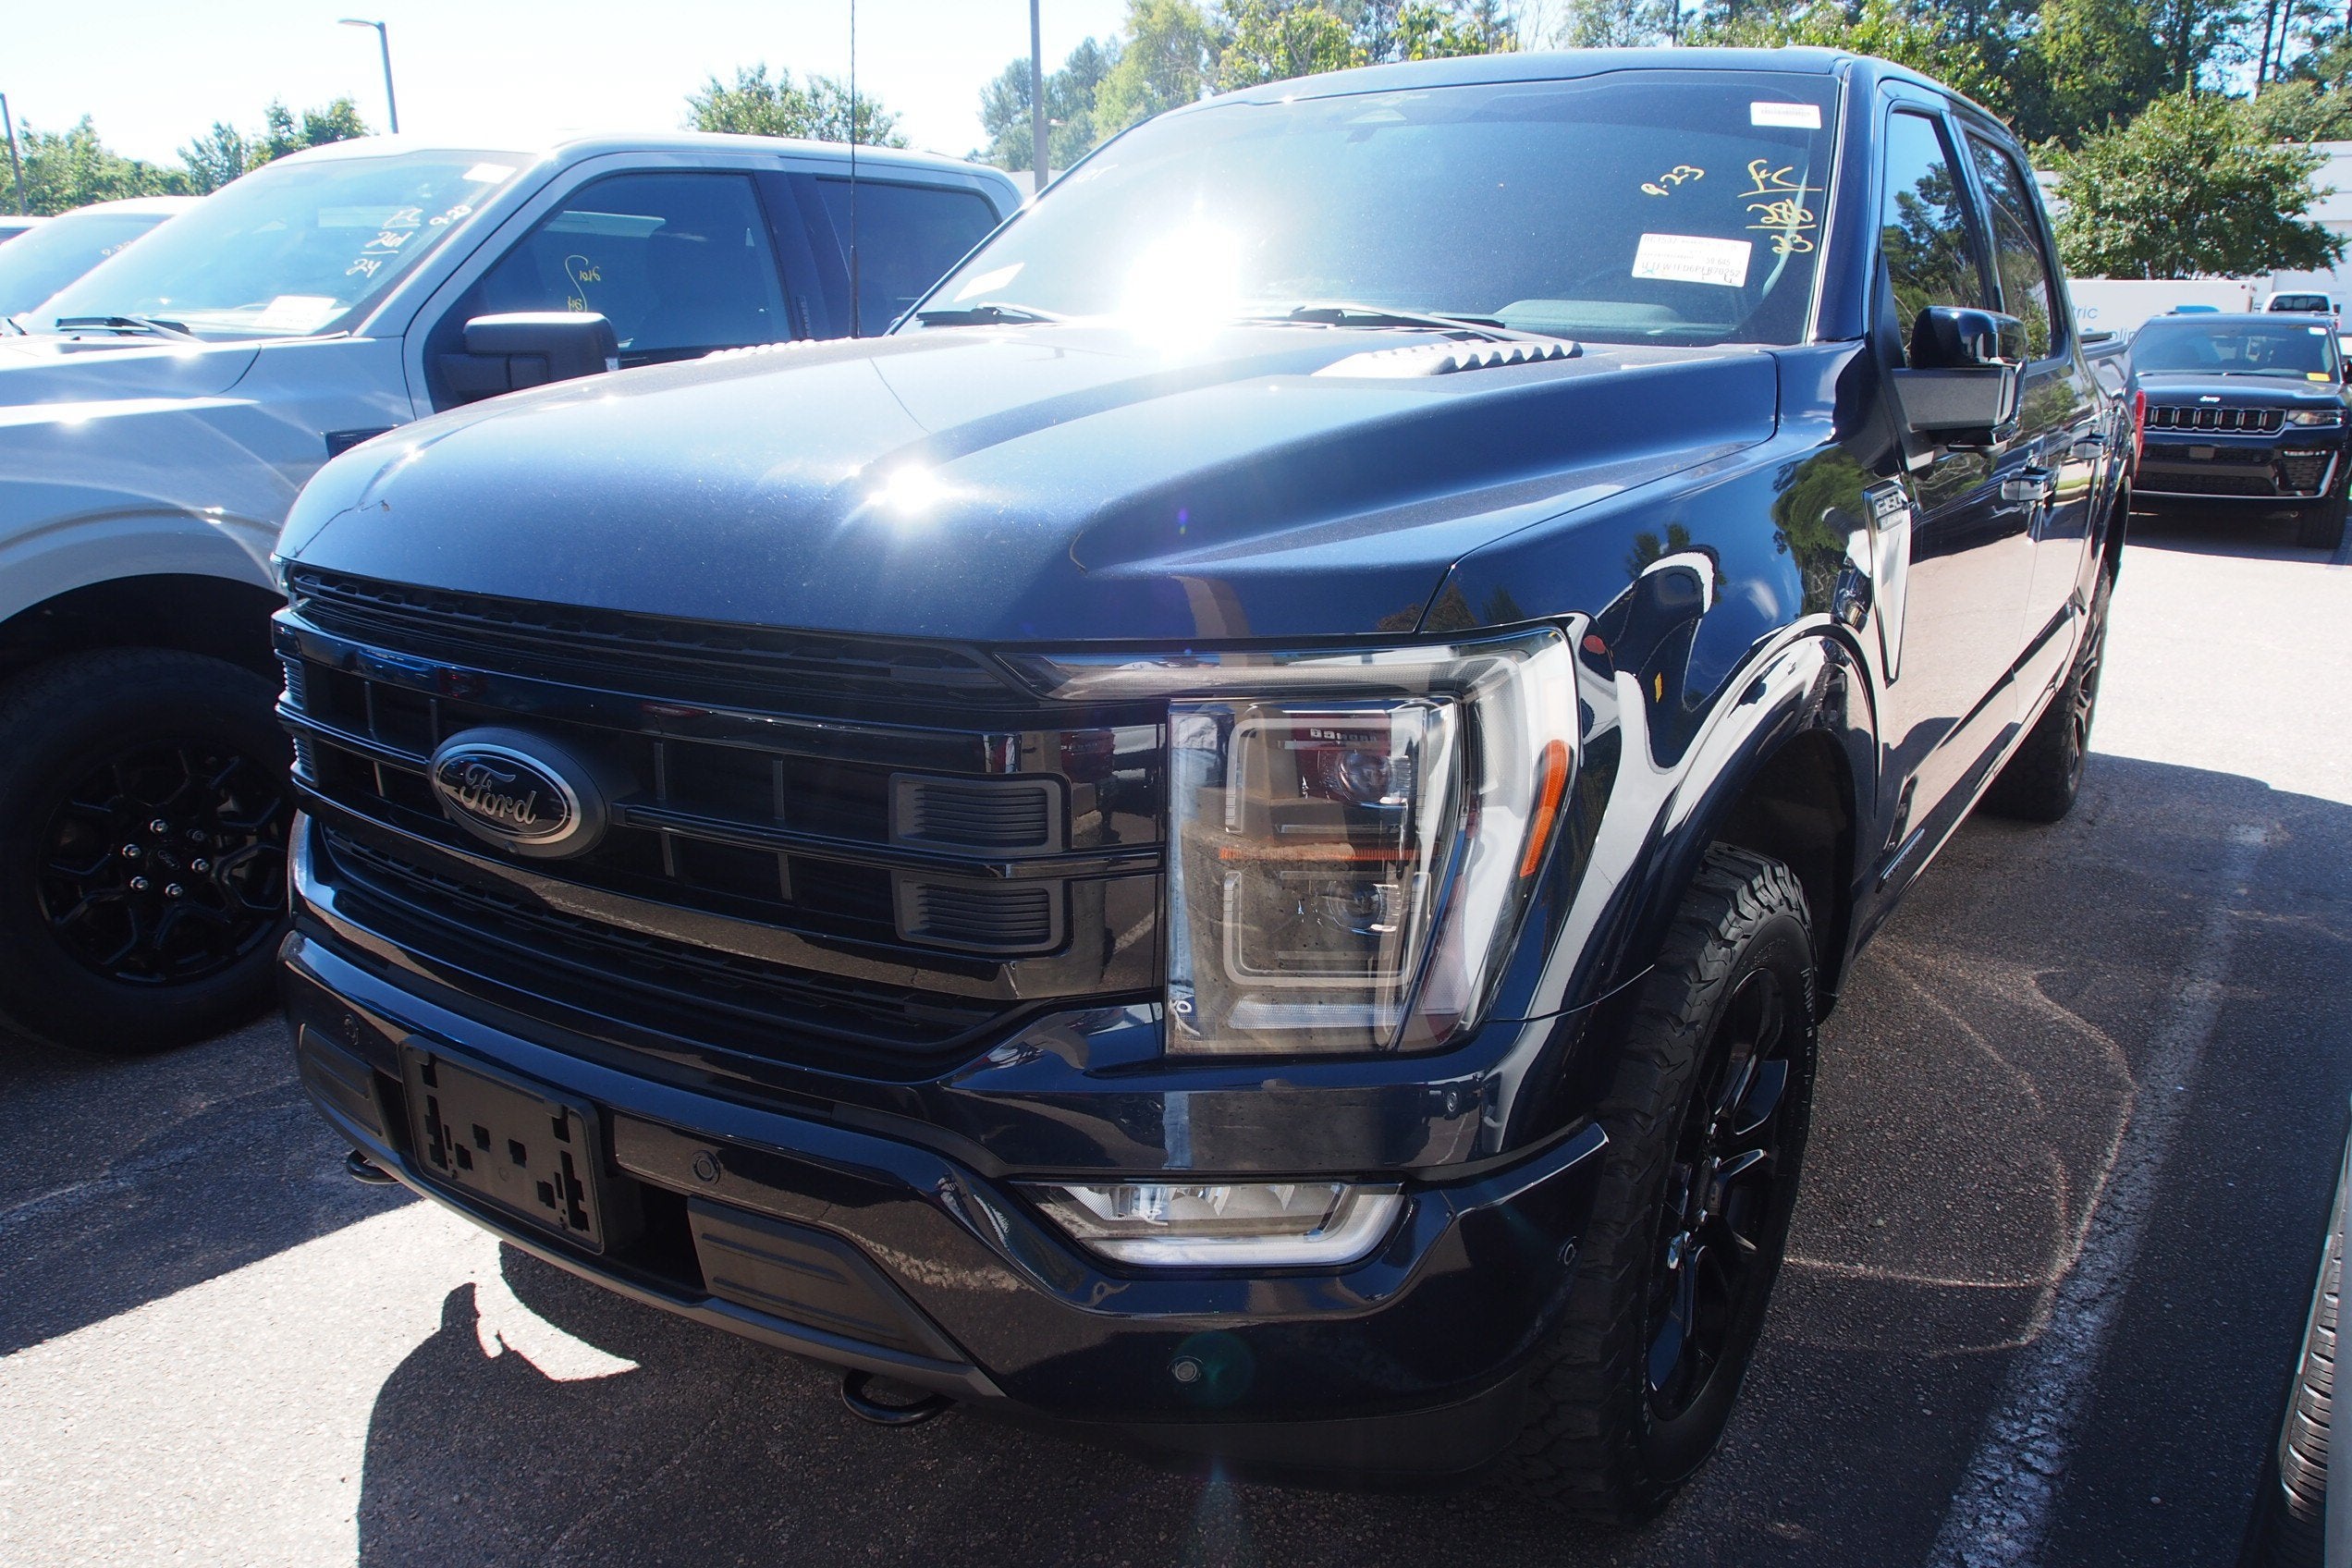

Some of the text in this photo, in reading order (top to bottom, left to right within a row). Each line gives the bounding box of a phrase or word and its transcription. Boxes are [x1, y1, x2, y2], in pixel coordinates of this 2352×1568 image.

[1640, 165, 1705, 196] 9.23
[2199, 395, 2221, 403] Jeep
[459, 763, 537, 826] Ford
